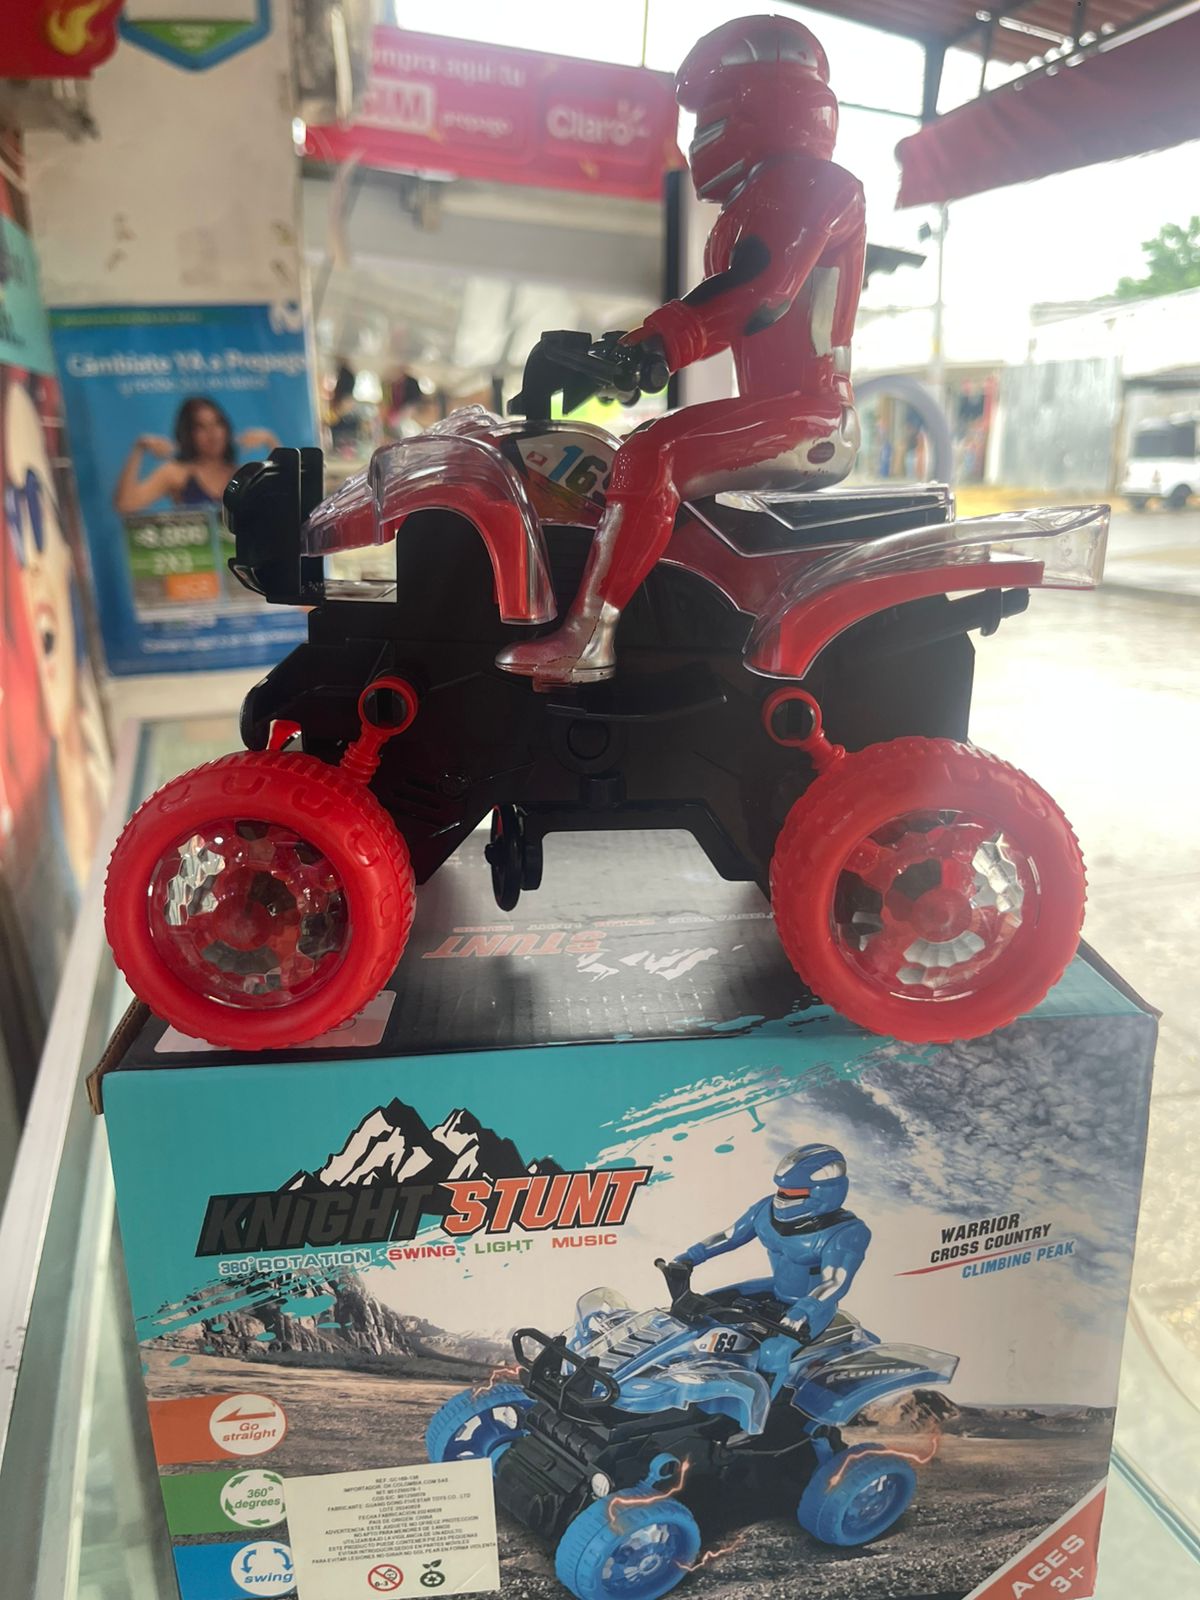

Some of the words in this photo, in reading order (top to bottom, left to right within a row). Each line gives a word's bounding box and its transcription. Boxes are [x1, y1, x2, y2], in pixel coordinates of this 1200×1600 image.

[547, 103, 633, 146] Claro
[421, 930, 607, 959] STUNT
[438, 1165, 654, 1238] STUNT
[930, 1241, 979, 1264] CROSS
[984, 1223, 1053, 1251] COUNTRY
[941, 1212, 1021, 1245] WARRIOR
[388, 1244, 458, 1262] SWING
[474, 1238, 535, 1255] LIGHT
[551, 1232, 618, 1249] MUSIC
[961, 1251, 1032, 1279] CLIMBING
[1036, 1240, 1076, 1262] PEAK
[222, 1428, 277, 1442] straight
[239, 1422, 260, 1432] Go
[235, 1496, 281, 1511] degrees
[244, 1571, 293, 1586] swing
[1011, 1534, 1086, 1600] AGES
[1050, 1565, 1085, 1593] 3+
